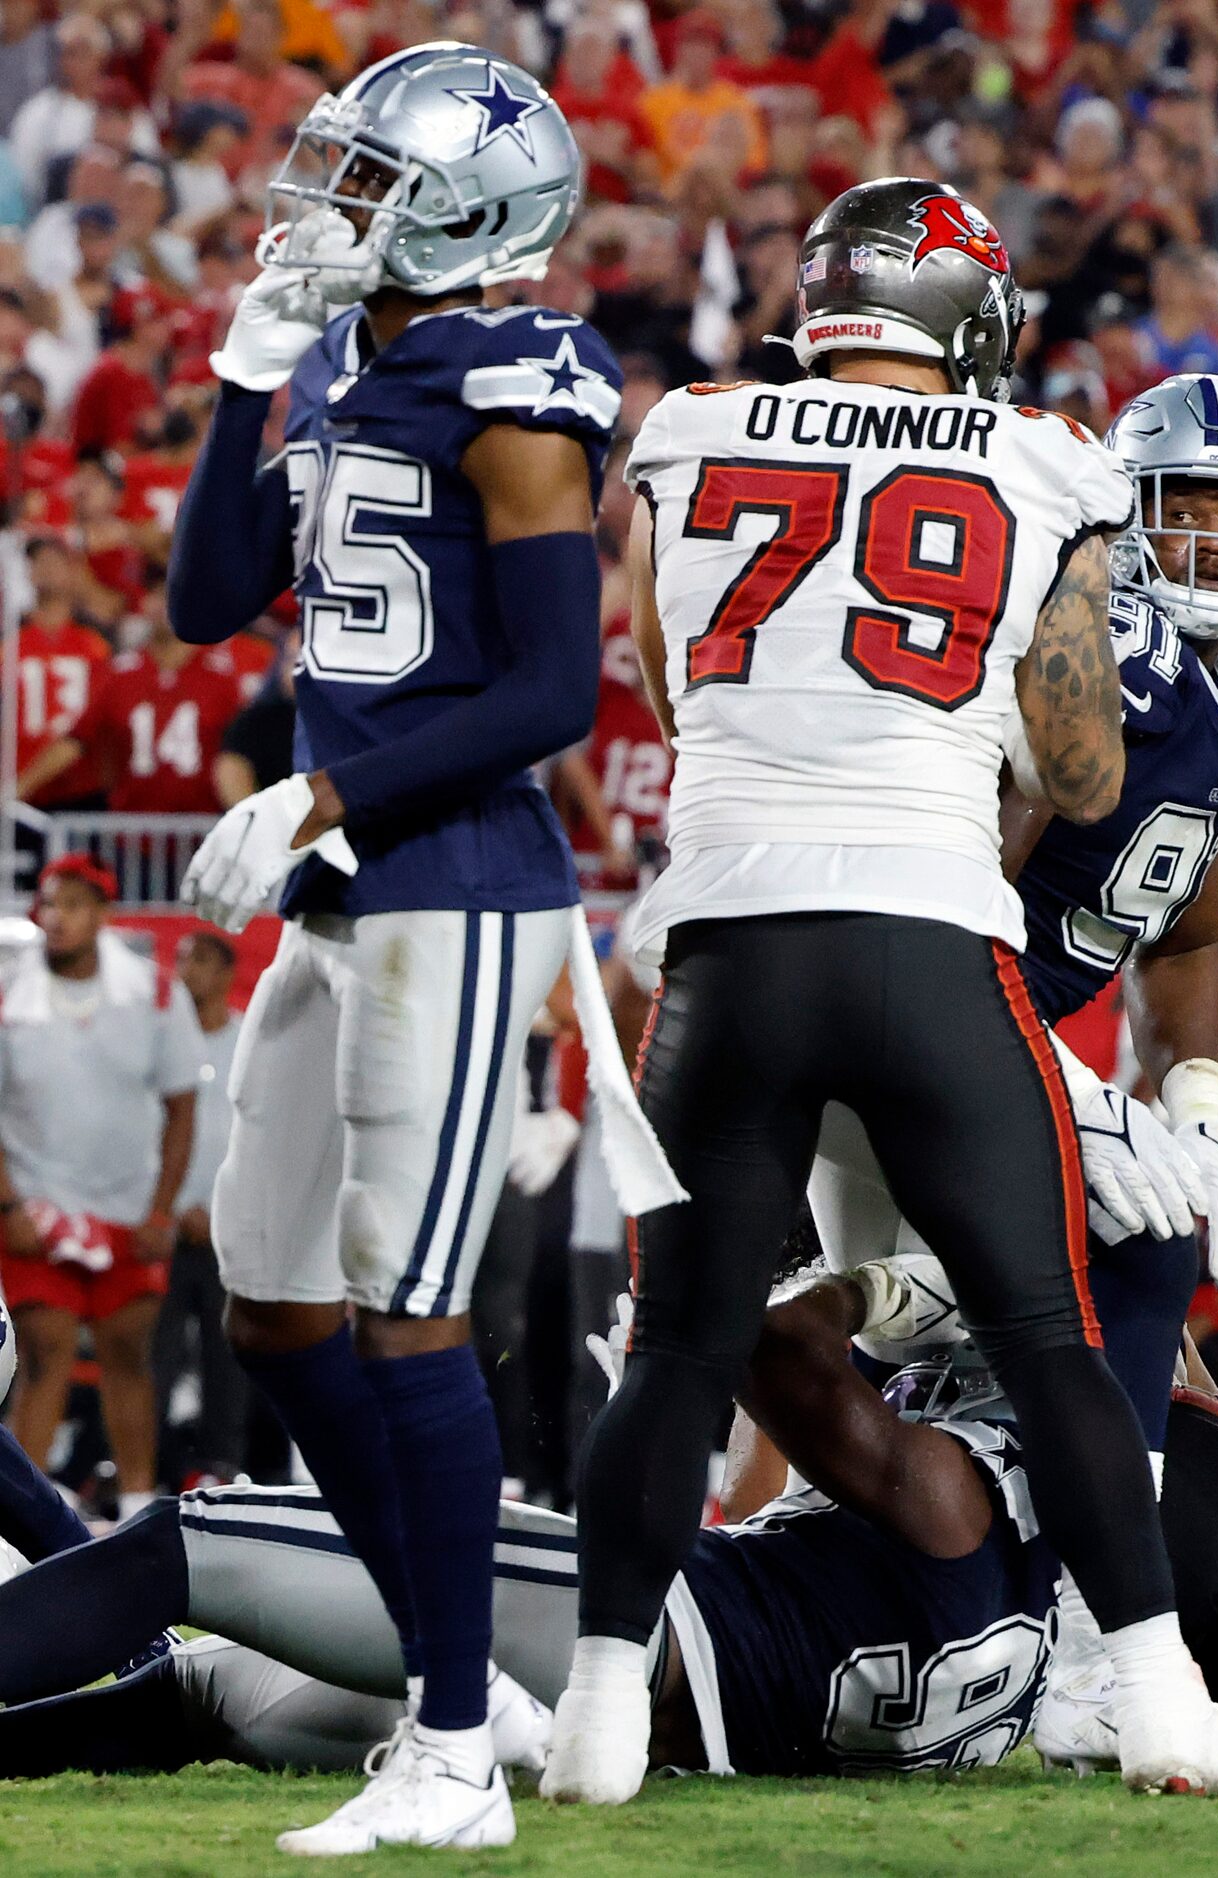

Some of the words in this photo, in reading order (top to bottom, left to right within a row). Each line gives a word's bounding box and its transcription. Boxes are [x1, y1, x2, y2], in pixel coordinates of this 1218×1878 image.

[806, 323, 883, 345] BUCCANEERS
[746, 394, 997, 459] O'CONNOR
[682, 457, 1017, 714] 79
[129, 702, 201, 777] 14
[602, 738, 671, 815] 12
